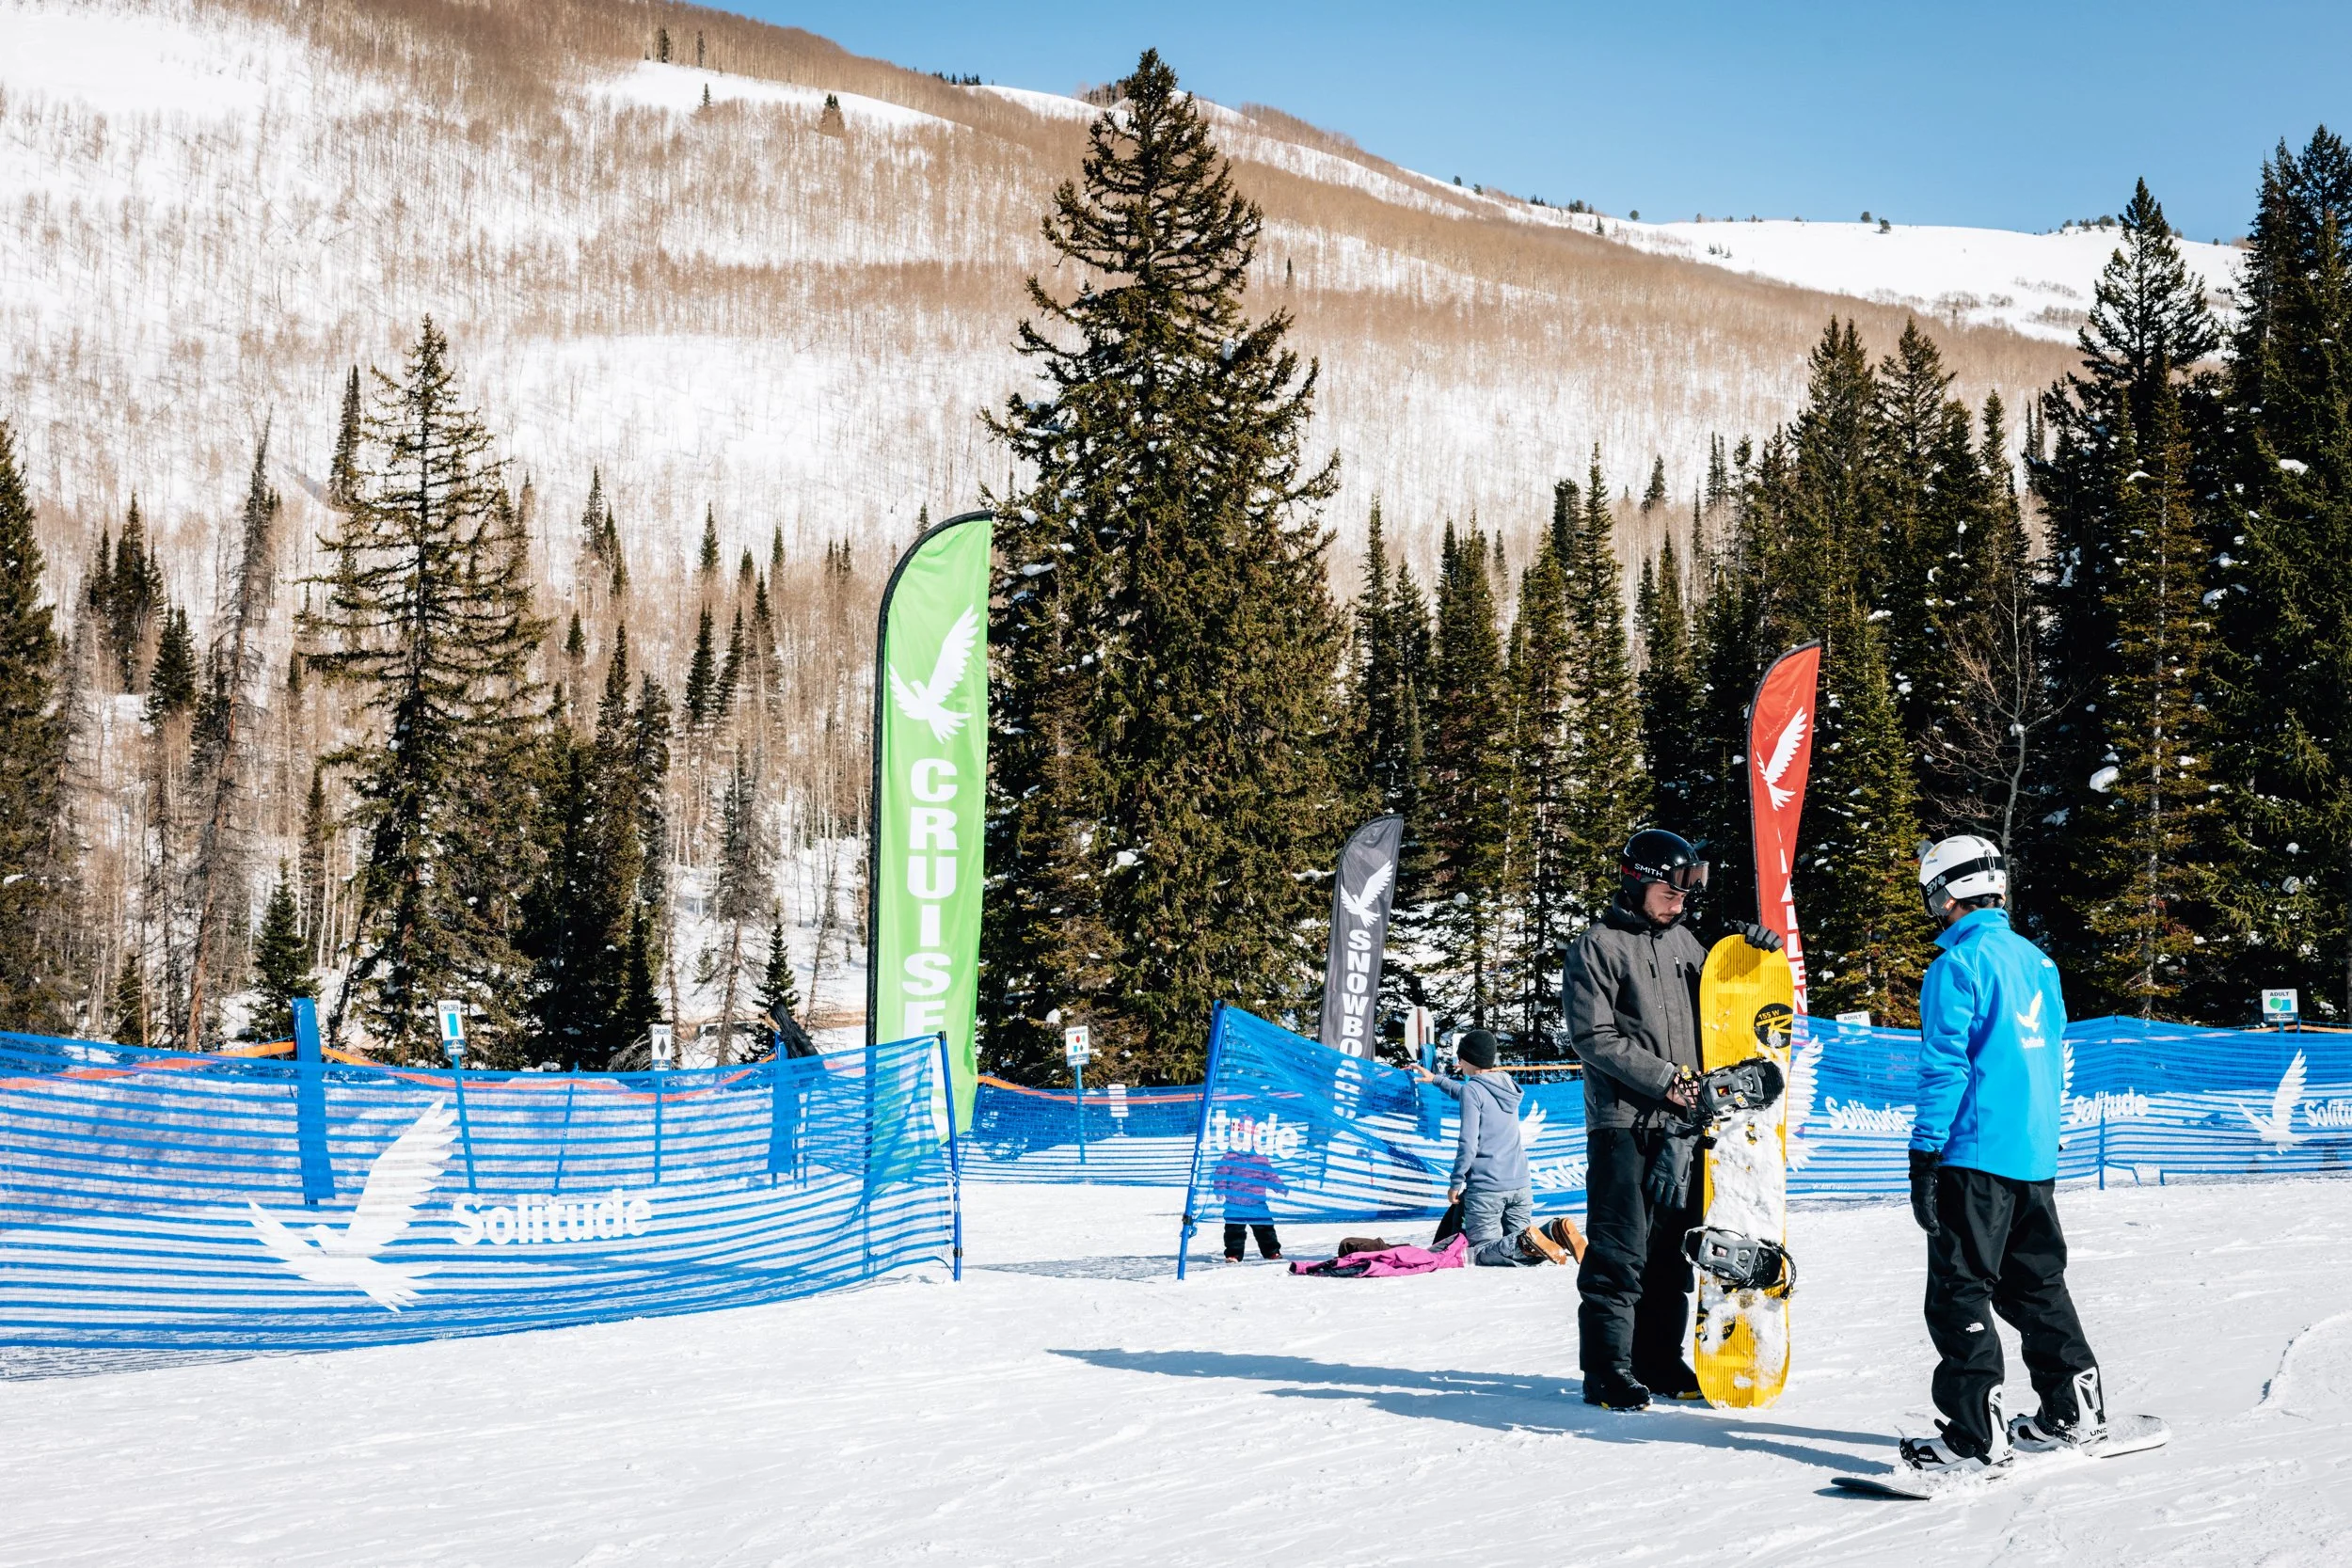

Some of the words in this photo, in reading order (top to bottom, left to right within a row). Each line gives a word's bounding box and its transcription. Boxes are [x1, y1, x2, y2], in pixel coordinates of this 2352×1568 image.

[1634, 863, 1663, 878] SMITH
[1758, 1011, 1772, 1021] 155
[1825, 1096, 1913, 1132] Solitude
[2069, 1086, 2148, 1123] Solitude
[450, 1188, 652, 1245] Solitude
